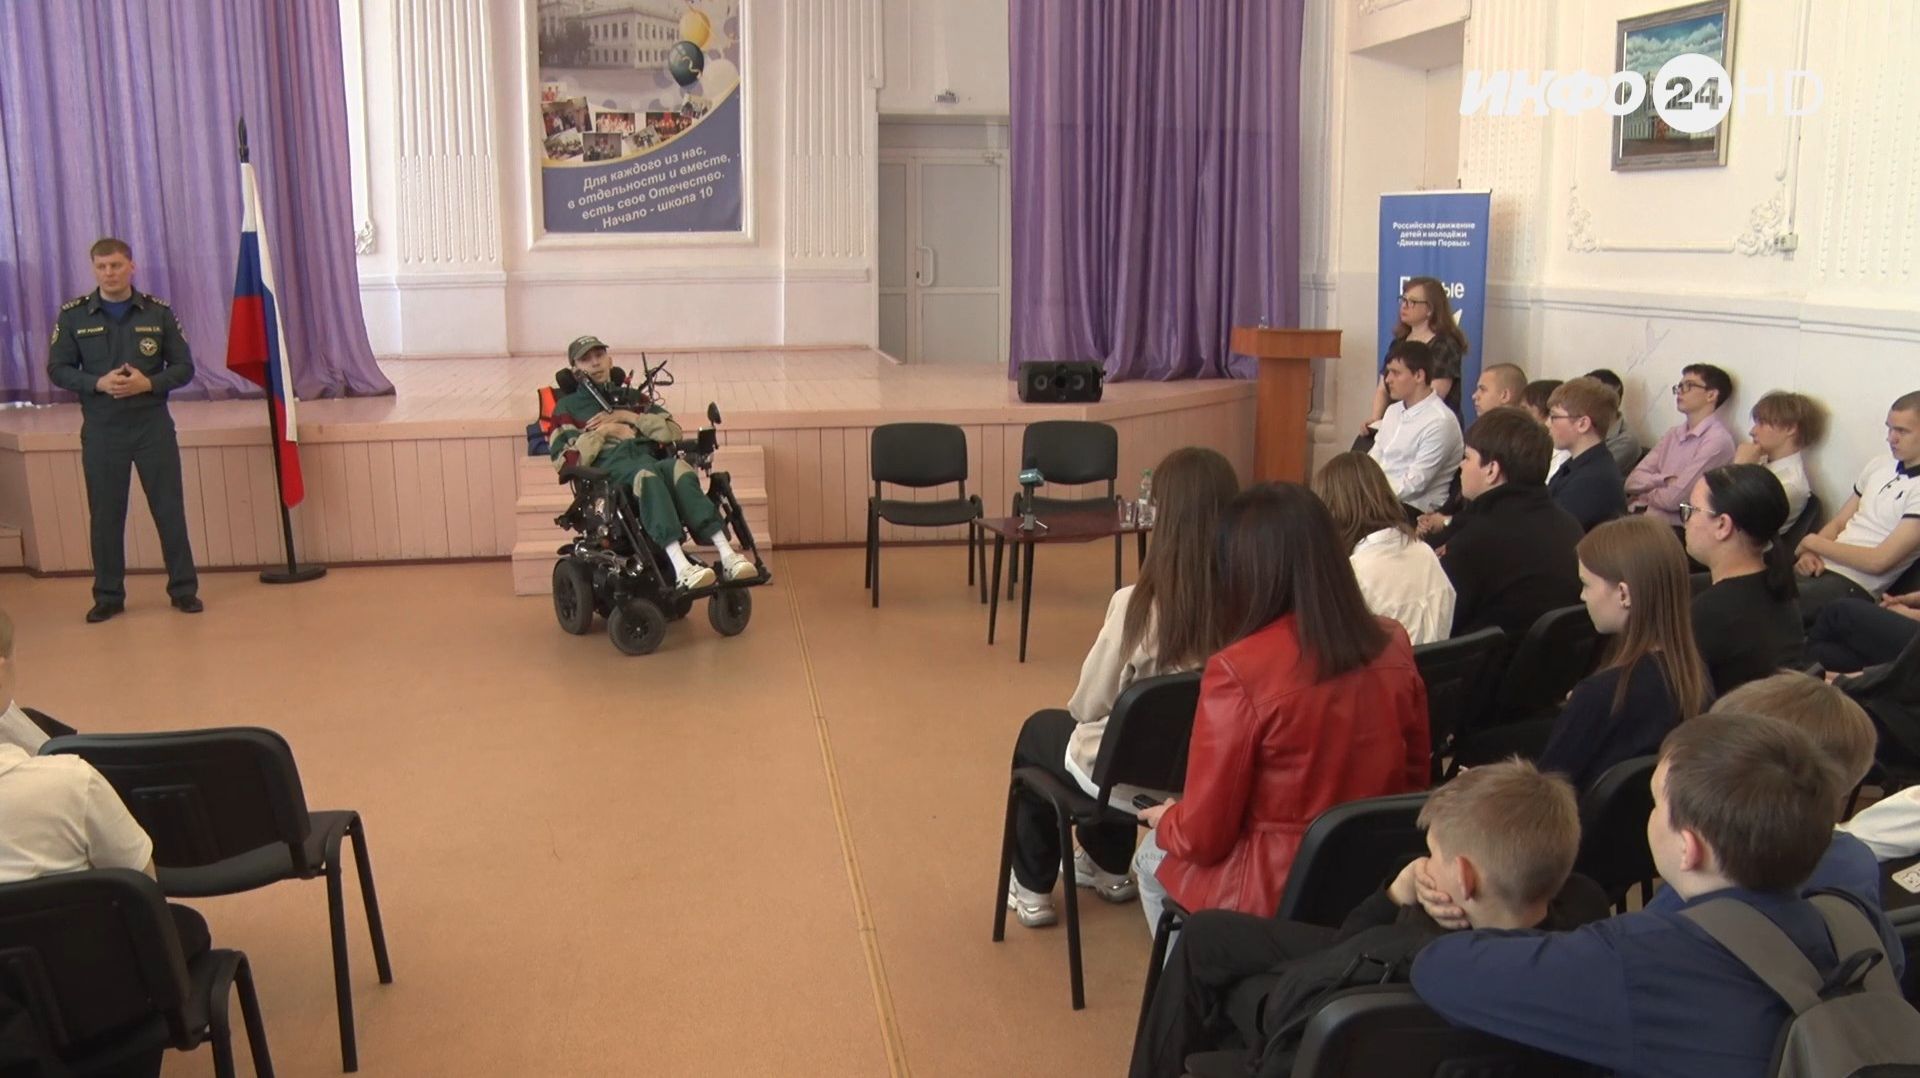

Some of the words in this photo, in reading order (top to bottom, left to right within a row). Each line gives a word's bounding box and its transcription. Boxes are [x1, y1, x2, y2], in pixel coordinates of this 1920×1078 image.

[567, 200, 575, 209] в
[578, 171, 666, 207] отдельности
[669, 168, 677, 179] и
[679, 154, 731, 174] вместе,
[583, 176, 608, 192] Для
[610, 159, 662, 182] каждого
[664, 154, 679, 166] из
[681, 147, 707, 160] нас,
[582, 203, 615, 220] есть
[617, 193, 646, 209] свое
[602, 208, 647, 229] Начало
[657, 193, 697, 212] школа
[699, 186, 714, 200] 10
[1392, 221, 1435, 230] Российское
[1436, 222, 1476, 230] движение
[1400, 231, 1422, 239] детей
